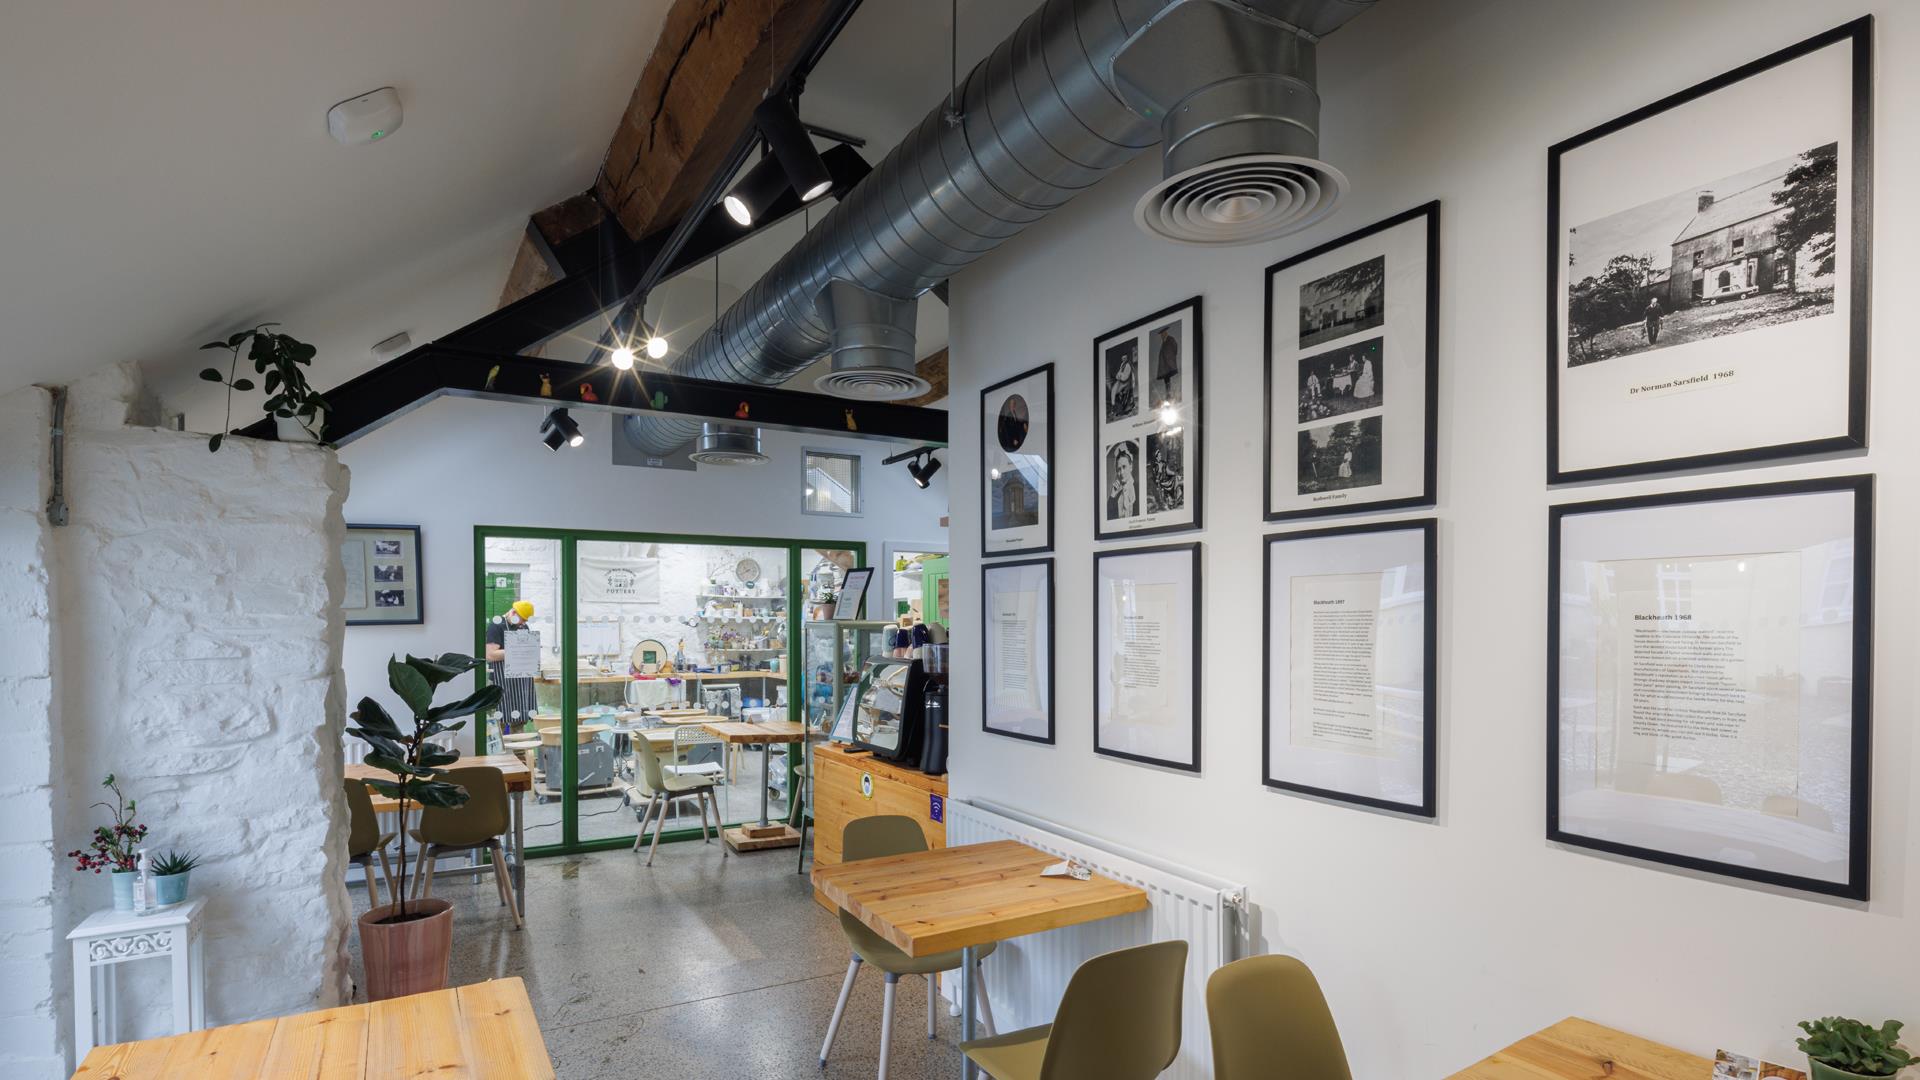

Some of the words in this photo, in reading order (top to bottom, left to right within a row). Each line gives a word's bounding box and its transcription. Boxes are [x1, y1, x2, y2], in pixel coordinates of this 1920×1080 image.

[1641, 382, 1672, 392] Norman
[1673, 374, 1709, 387] Sarsfield
[1713, 370, 1735, 380] 1968
